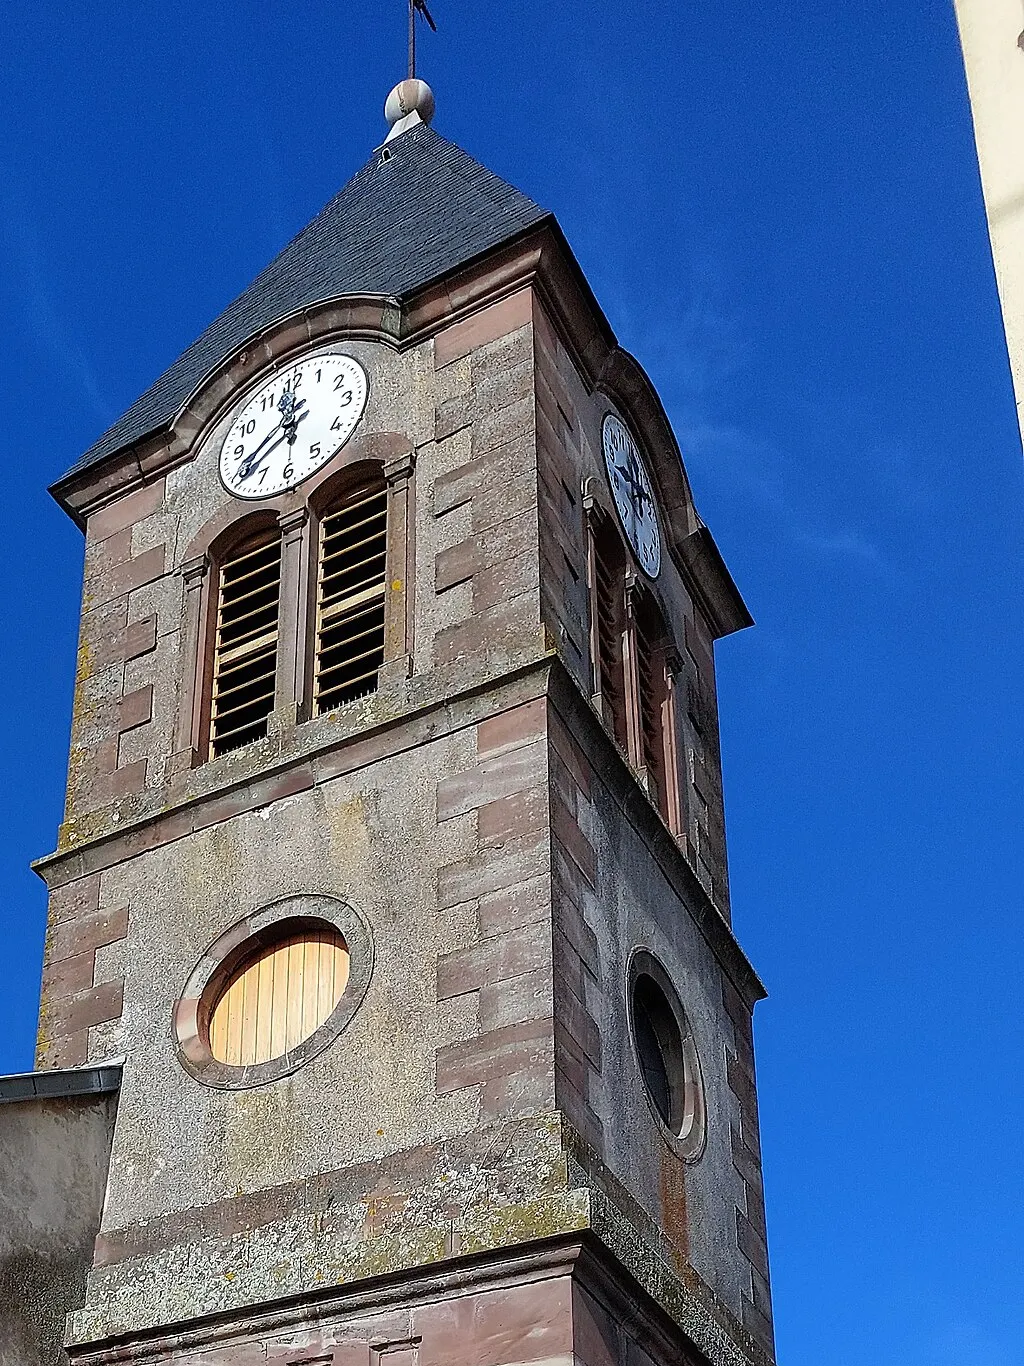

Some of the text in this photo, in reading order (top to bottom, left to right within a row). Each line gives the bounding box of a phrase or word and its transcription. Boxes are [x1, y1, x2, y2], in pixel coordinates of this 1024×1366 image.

[284, 372, 302, 392] 12
[315, 368, 322, 384] 1
[332, 373, 345, 392] 2
[260, 393, 274, 412] 11
[339, 389, 353, 408] 3
[239, 418, 256, 438] 10
[330, 416, 343, 431] 4
[233, 444, 245, 461] 9
[309, 441, 321, 459] 5
[257, 466, 270, 485] 7
[282, 462, 294, 479] 6
